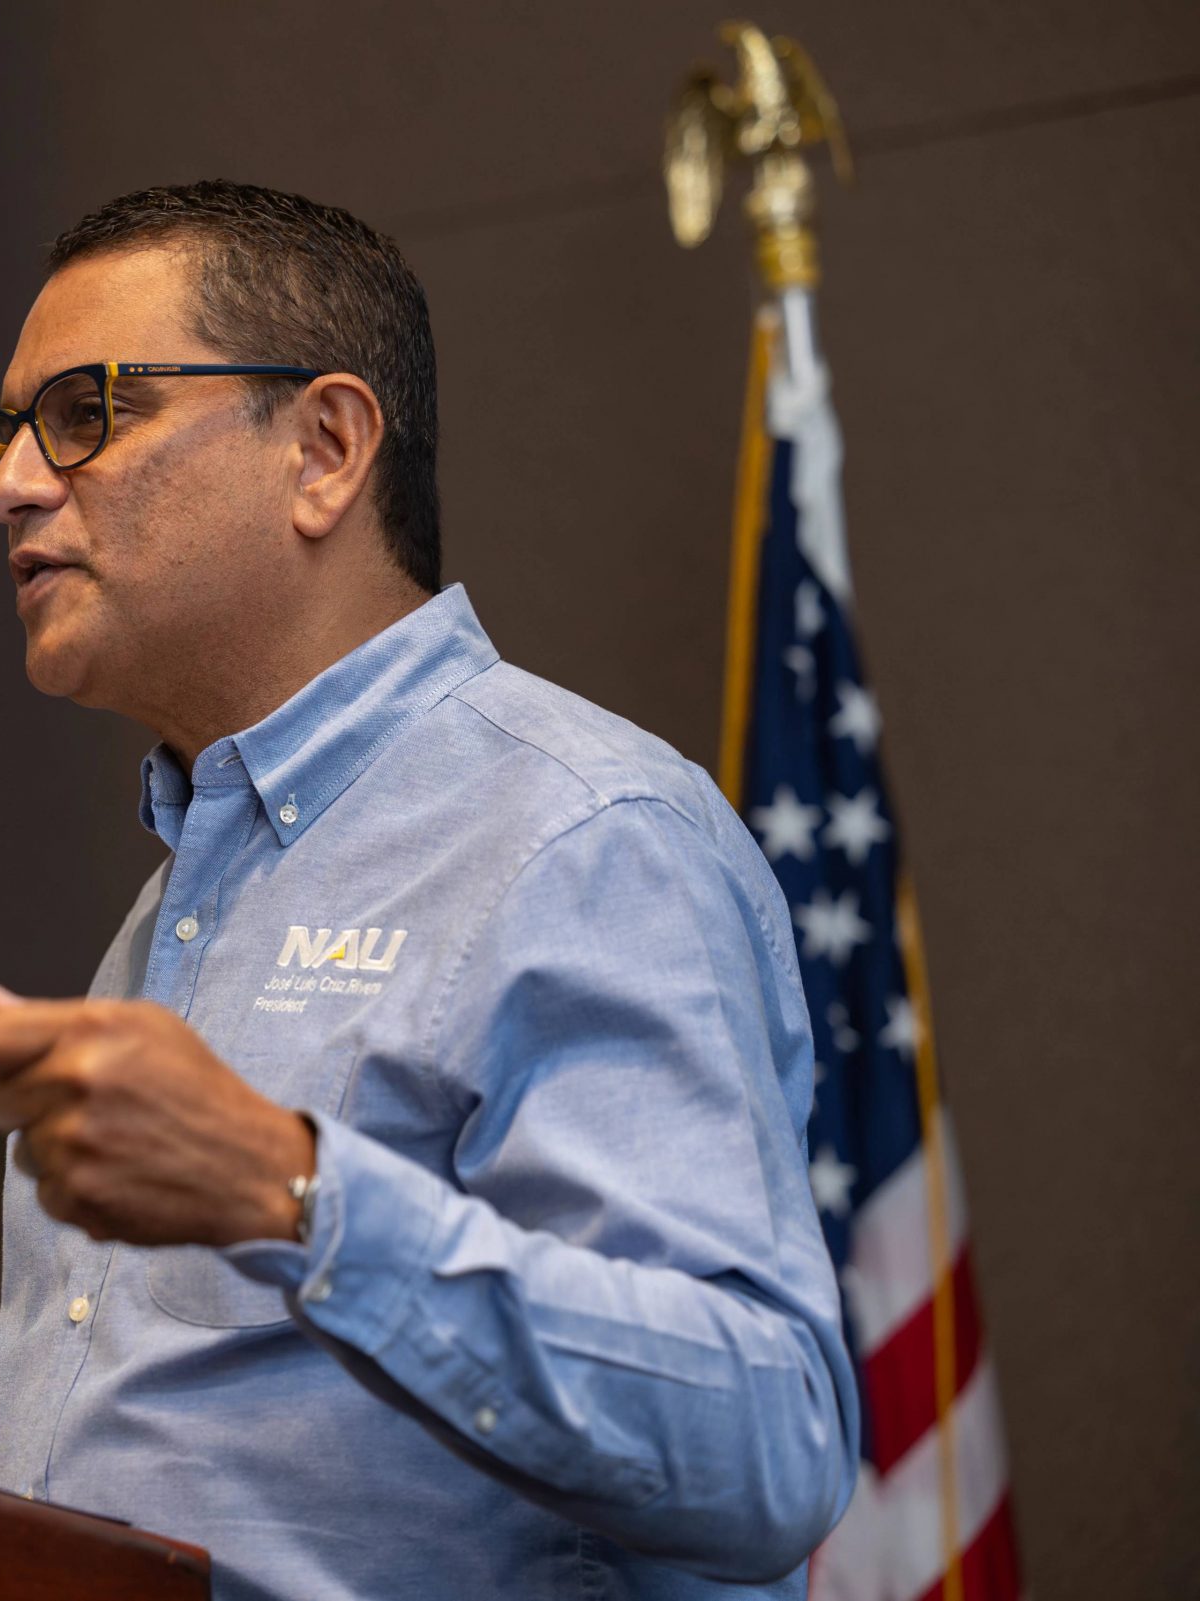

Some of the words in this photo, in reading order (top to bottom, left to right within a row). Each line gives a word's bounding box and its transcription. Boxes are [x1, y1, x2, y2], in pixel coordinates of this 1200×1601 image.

[276, 925, 408, 971] NAU
[320, 975, 347, 993] Cruz
[252, 996, 308, 1013] President
